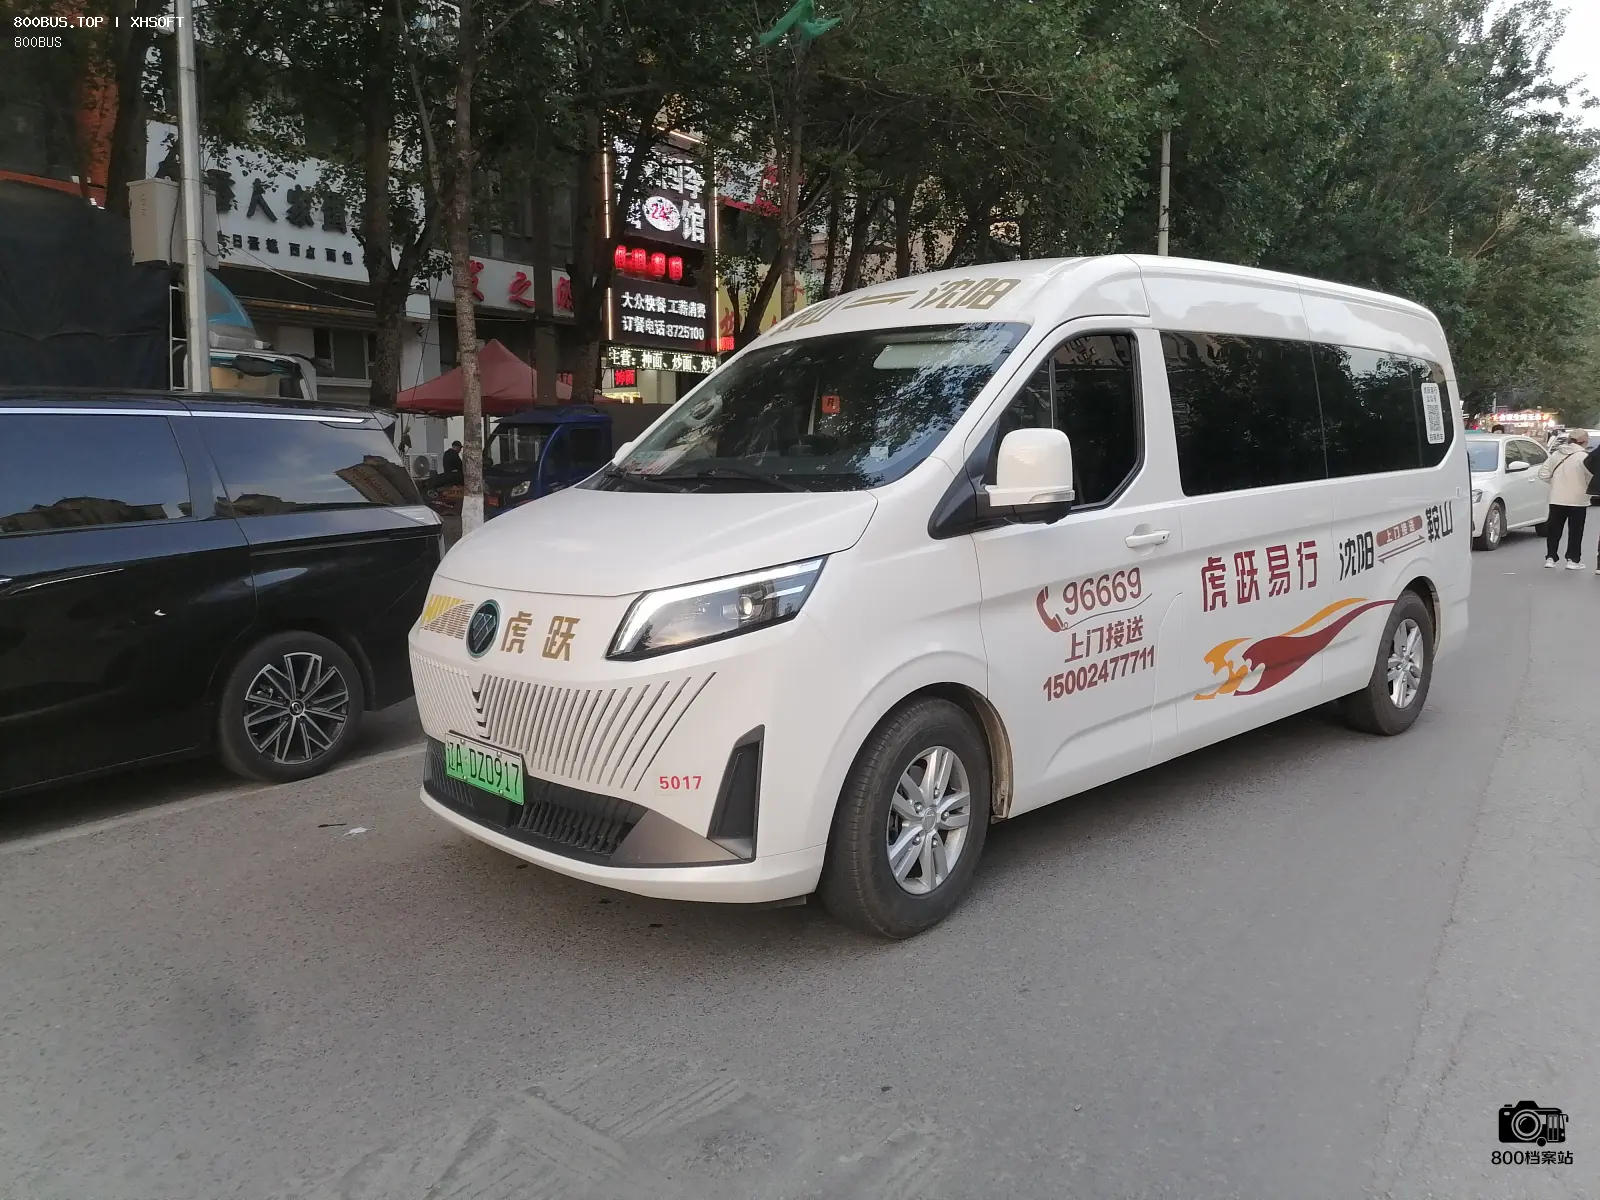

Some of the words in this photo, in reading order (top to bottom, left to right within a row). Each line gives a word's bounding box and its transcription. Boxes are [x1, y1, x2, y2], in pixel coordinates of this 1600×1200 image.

[620, 291, 667, 313] 大众快餐
[909, 277, 1022, 310] 沈阳
[1338, 530, 1375, 582] 沈阳
[1425, 500, 1454, 544] 鞍山
[1062, 566, 1143, 616] 96669
[1200, 539, 1319, 614] 虎跃易行
[500, 610, 581, 662] 虎跃
[1063, 614, 1145, 664] 上门接送
[1041, 644, 1156, 702] 15002477711
[658, 775, 703, 791] 5017
